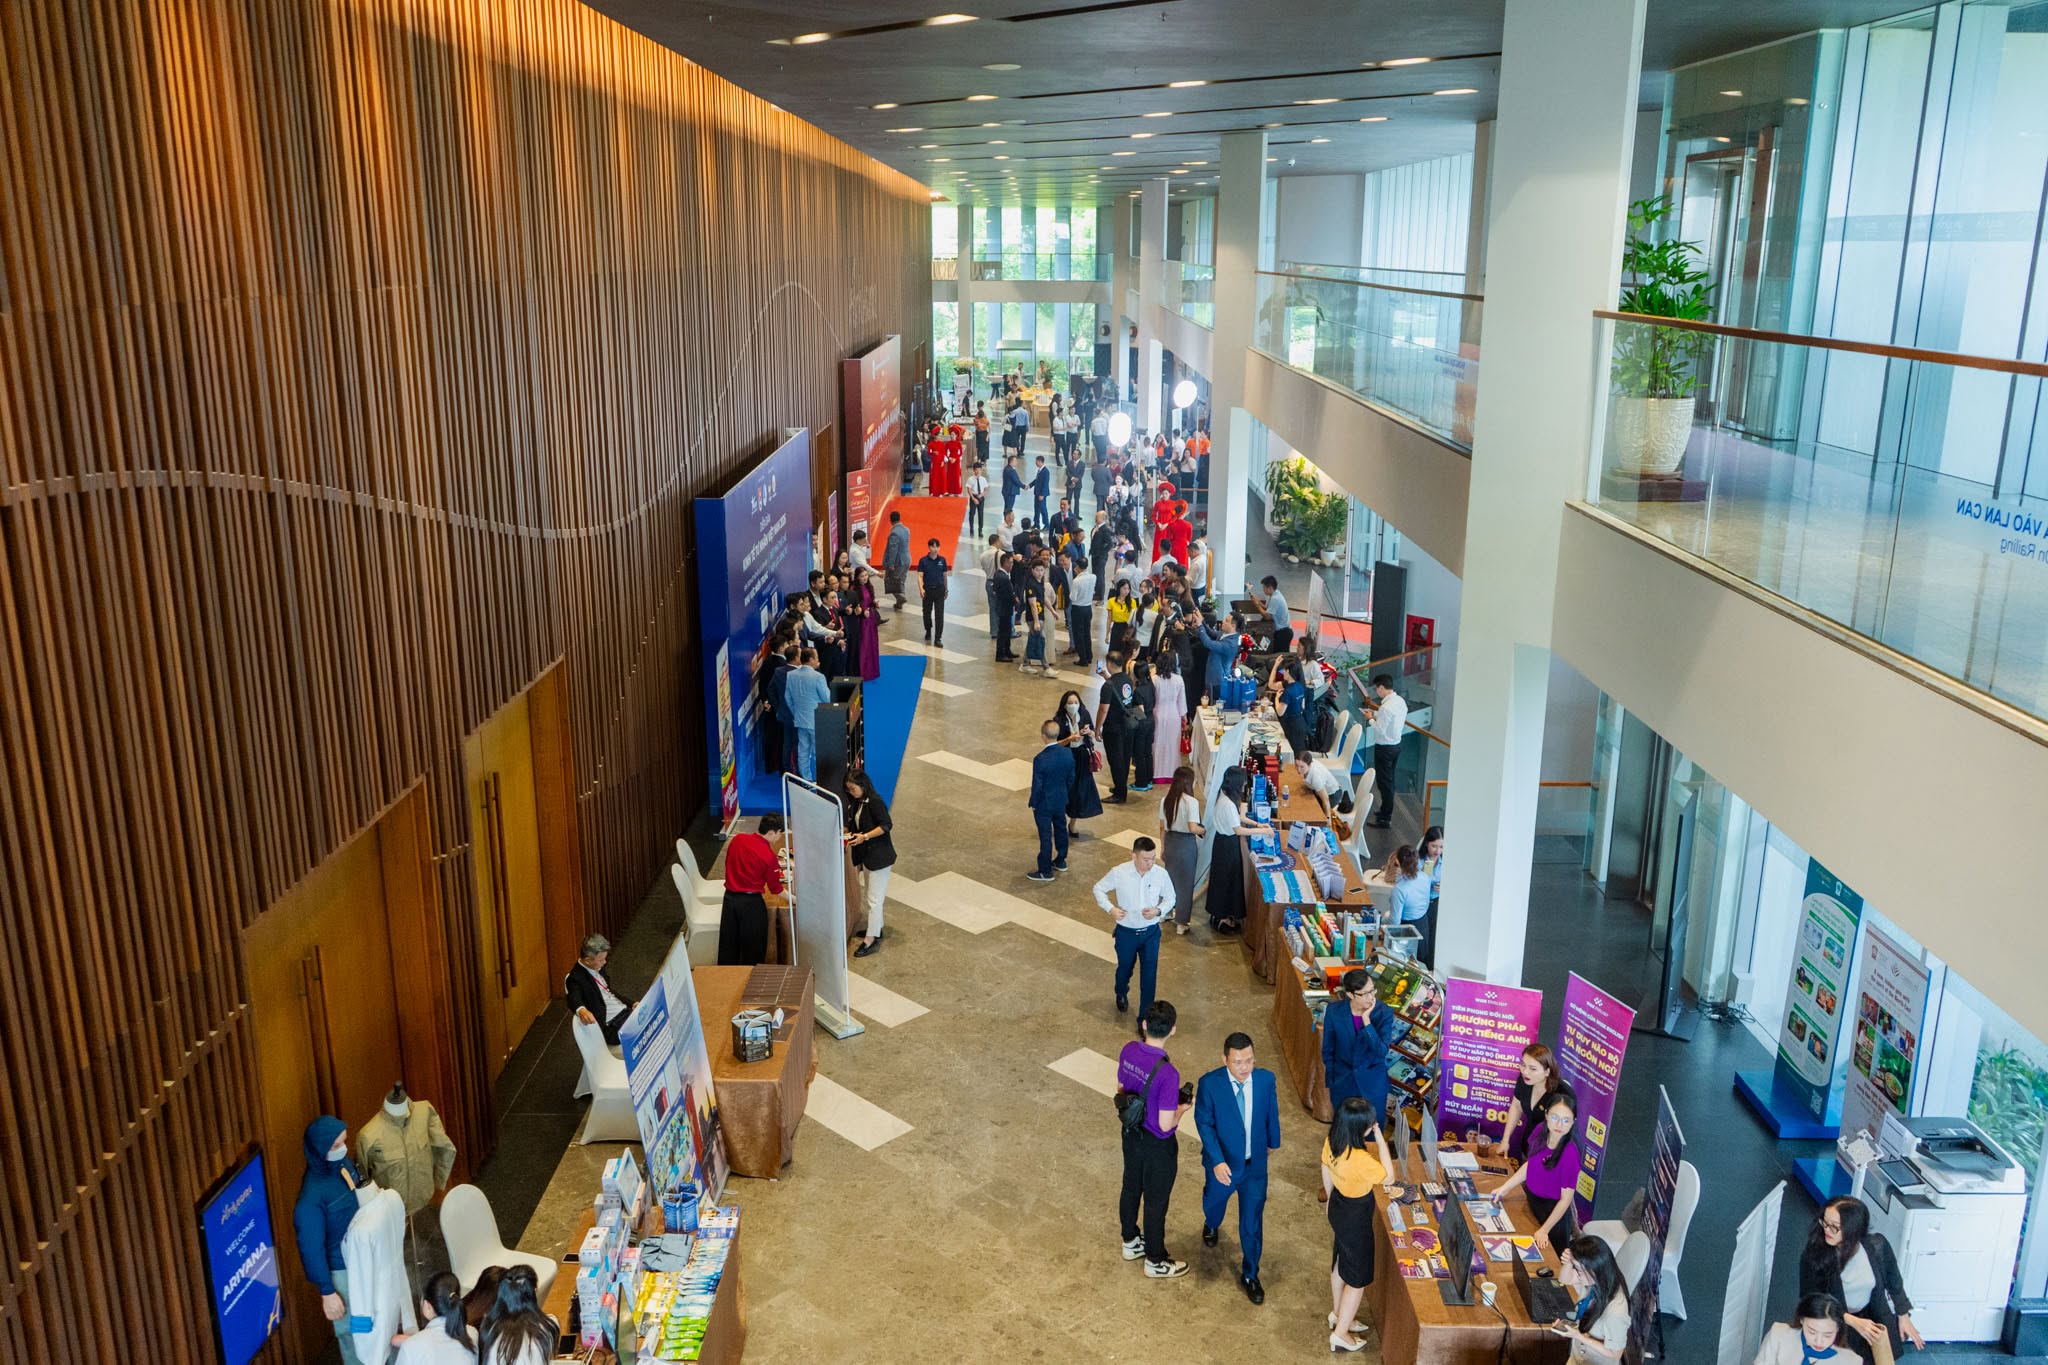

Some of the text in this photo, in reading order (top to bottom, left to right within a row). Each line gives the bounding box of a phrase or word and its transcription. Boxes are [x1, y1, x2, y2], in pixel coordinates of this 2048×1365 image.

[1451, 1013, 1527, 1032] PHƯƠNG PHÁP
[1450, 1025, 1531, 1045] HỌC TIẾNG ANH
[1566, 1023, 1577, 1036] TƯ
[1576, 1031, 1591, 1046] DUY
[1591, 1041, 1607, 1057] NÃO
[1607, 1051, 1619, 1066] BỘ
[1564, 1035, 1575, 1050] VÀ
[1575, 1044, 1598, 1065] NGÔN
[1598, 1060, 1618, 1077] NGỮ
[1479, 1068, 1499, 1077] STEP
[1445, 1100, 1460, 1109] RÚT
[1471, 1089, 1510, 1102] LISTENING
[1589, 1123, 1604, 1136] NLP
[225, 1218, 256, 1256] WELCOME
[238, 1244, 247, 1258] TO
[223, 1241, 268, 1302] ARIYANA
